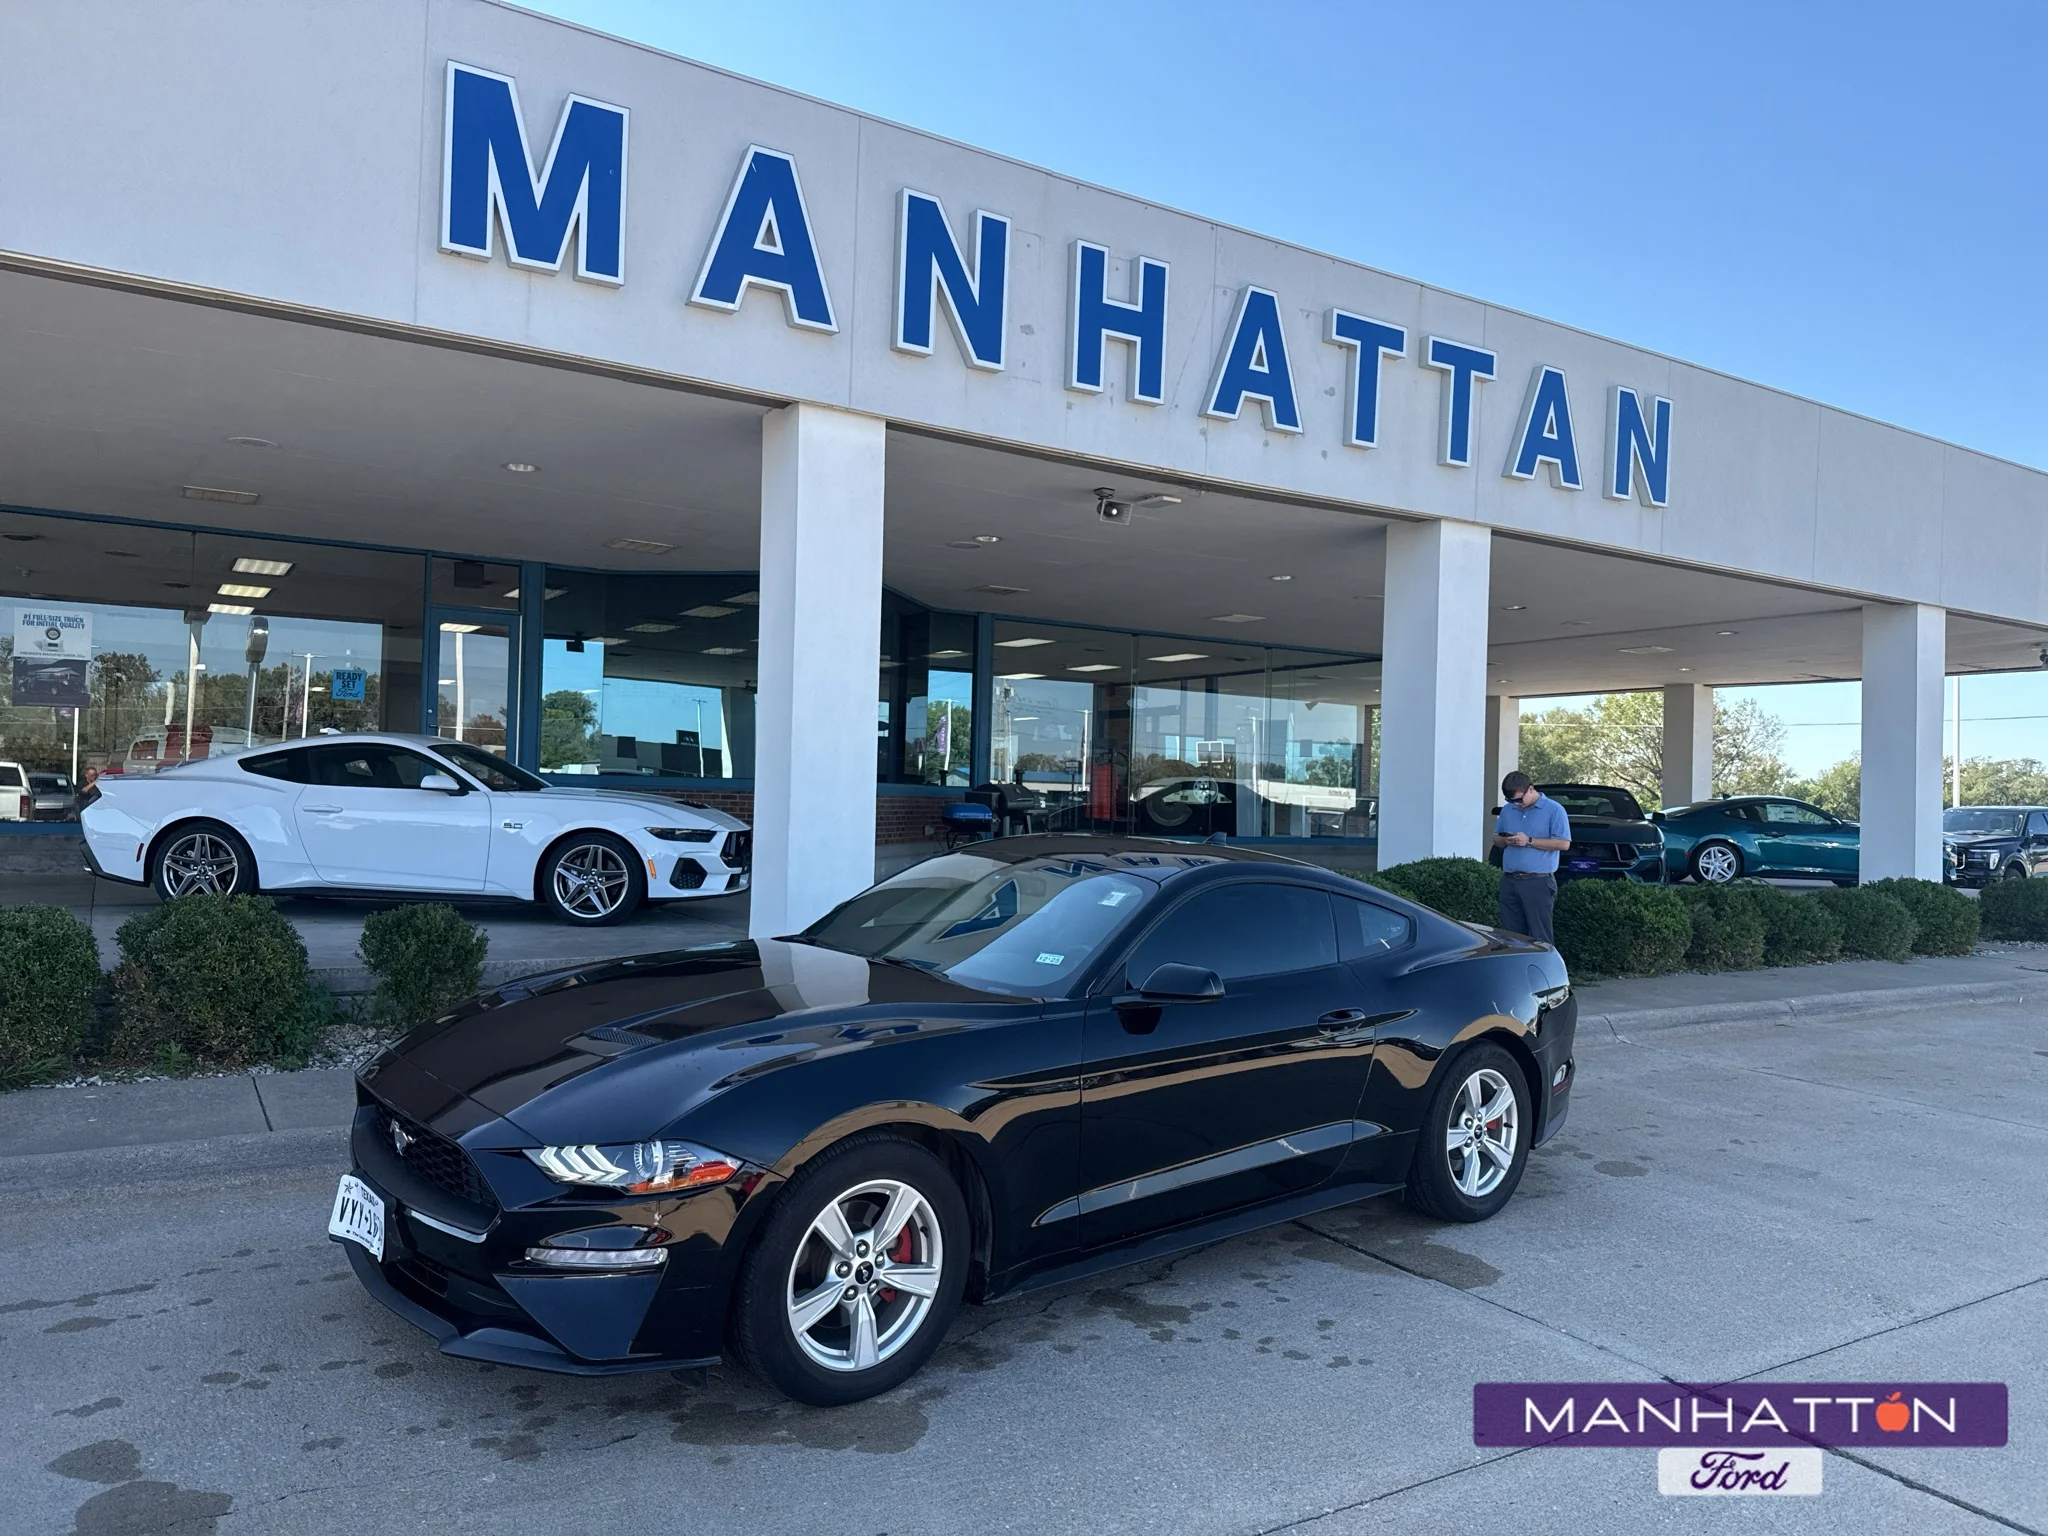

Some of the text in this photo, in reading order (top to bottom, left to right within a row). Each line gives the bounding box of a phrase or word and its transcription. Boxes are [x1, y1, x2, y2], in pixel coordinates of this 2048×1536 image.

[438, 60, 1672, 508] MANHATTAN
[336, 671, 363, 681] READY
[341, 681, 356, 689] SET
[336, 687, 362, 698] Ford
[360, 1186, 376, 1207] TEXAS
